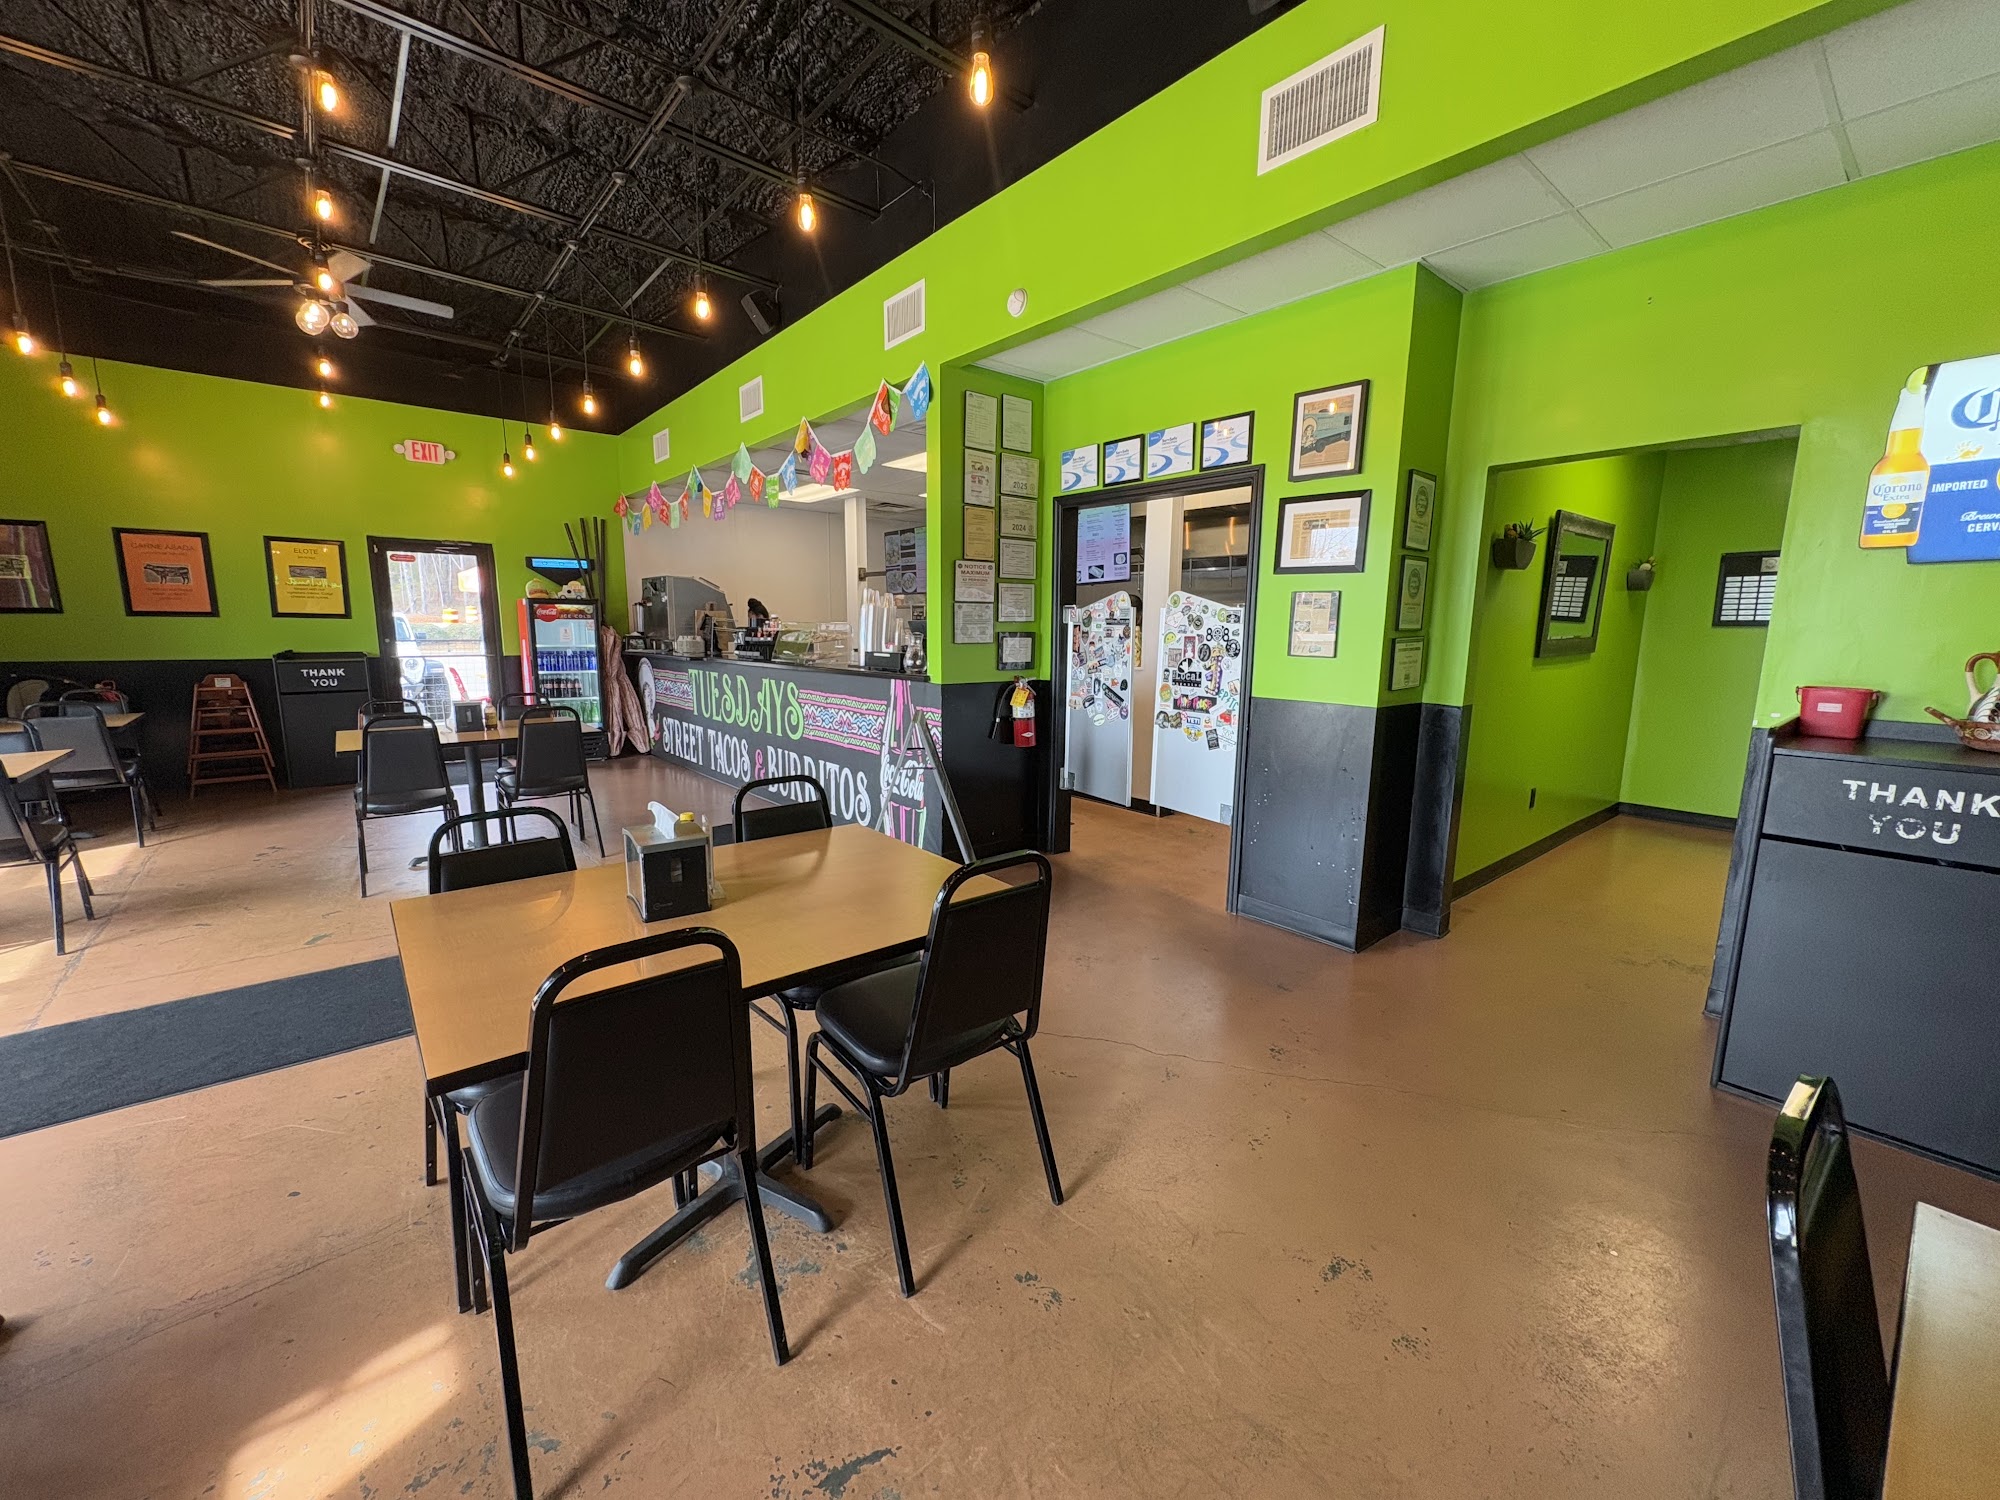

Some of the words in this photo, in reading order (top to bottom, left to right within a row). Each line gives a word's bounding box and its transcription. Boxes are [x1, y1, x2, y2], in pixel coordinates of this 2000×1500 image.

[411, 441, 440, 462] EXIT
[1013, 481, 1028, 490] 2025
[1873, 482, 1922, 497] Corona
[1931, 479, 1988, 493] IMPORTED
[1883, 493, 1910, 501] Extra
[1011, 523, 1026, 532] 2024
[1967, 522, 2000, 533] CERV
[293, 547, 319, 555] ELOTE
[536, 608, 557, 616] Coca-Cola
[300, 668, 346, 677] THANK
[310, 678, 338, 687] YOU
[687, 668, 804, 741] TUESDAYS
[1187, 717, 1201, 725] YETI
[662, 716, 704, 765] STREET
[707, 729, 751, 783] TACOS
[755, 748, 766, 781] &
[766, 745, 872, 827] BURRITOS
[1842, 779, 2000, 819] THANK
[1868, 813, 1962, 845] YOU
